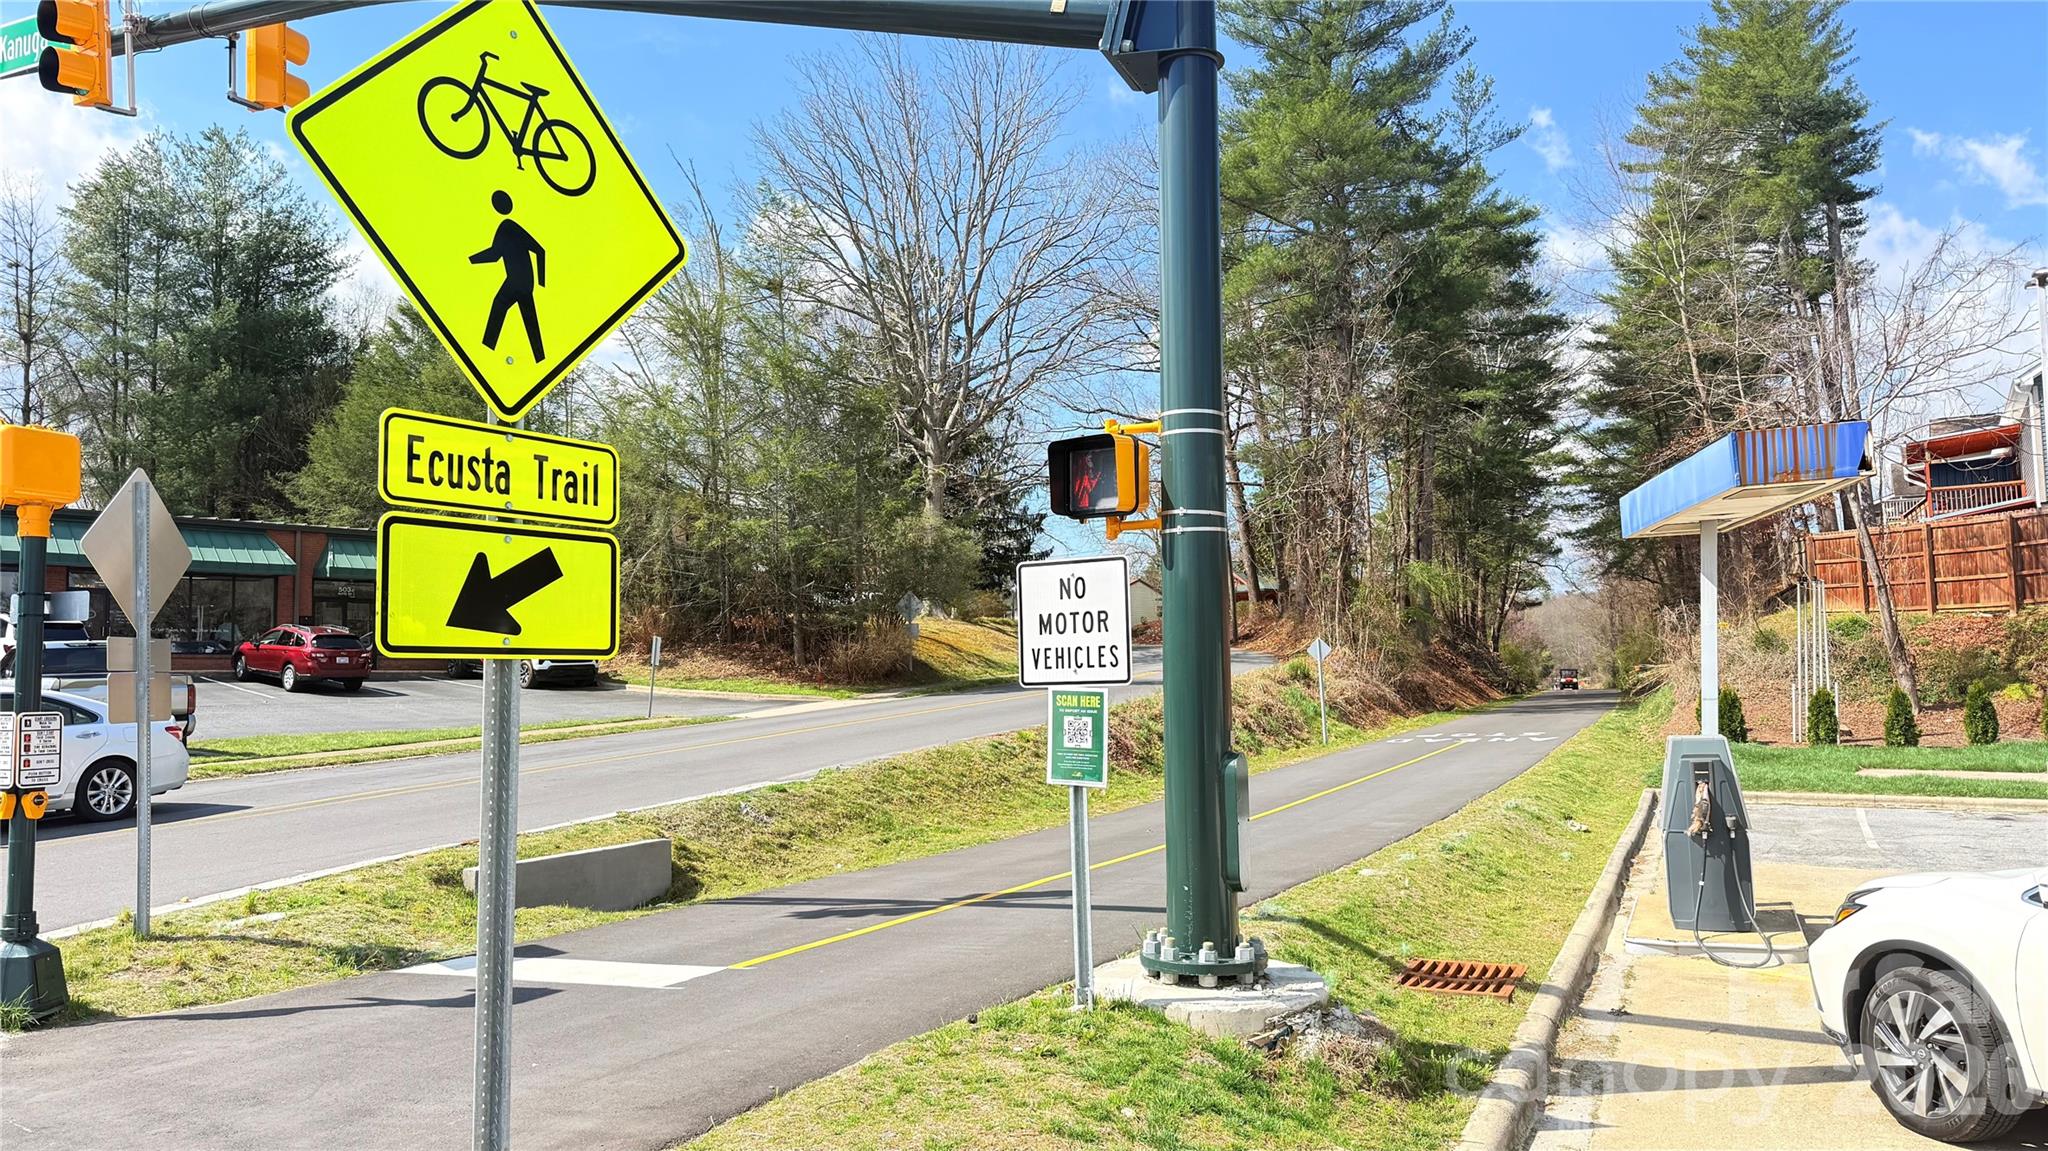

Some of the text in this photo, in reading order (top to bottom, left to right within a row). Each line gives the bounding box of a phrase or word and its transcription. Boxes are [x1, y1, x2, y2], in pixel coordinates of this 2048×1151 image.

[406, 434, 599, 507] Ecusta Trail
[1059, 576, 1086, 600] NO
[1039, 610, 1109, 635] MOTOR
[1031, 644, 1119, 670] VEHICLES
[1055, 694, 1101, 708] SCAN HERE
